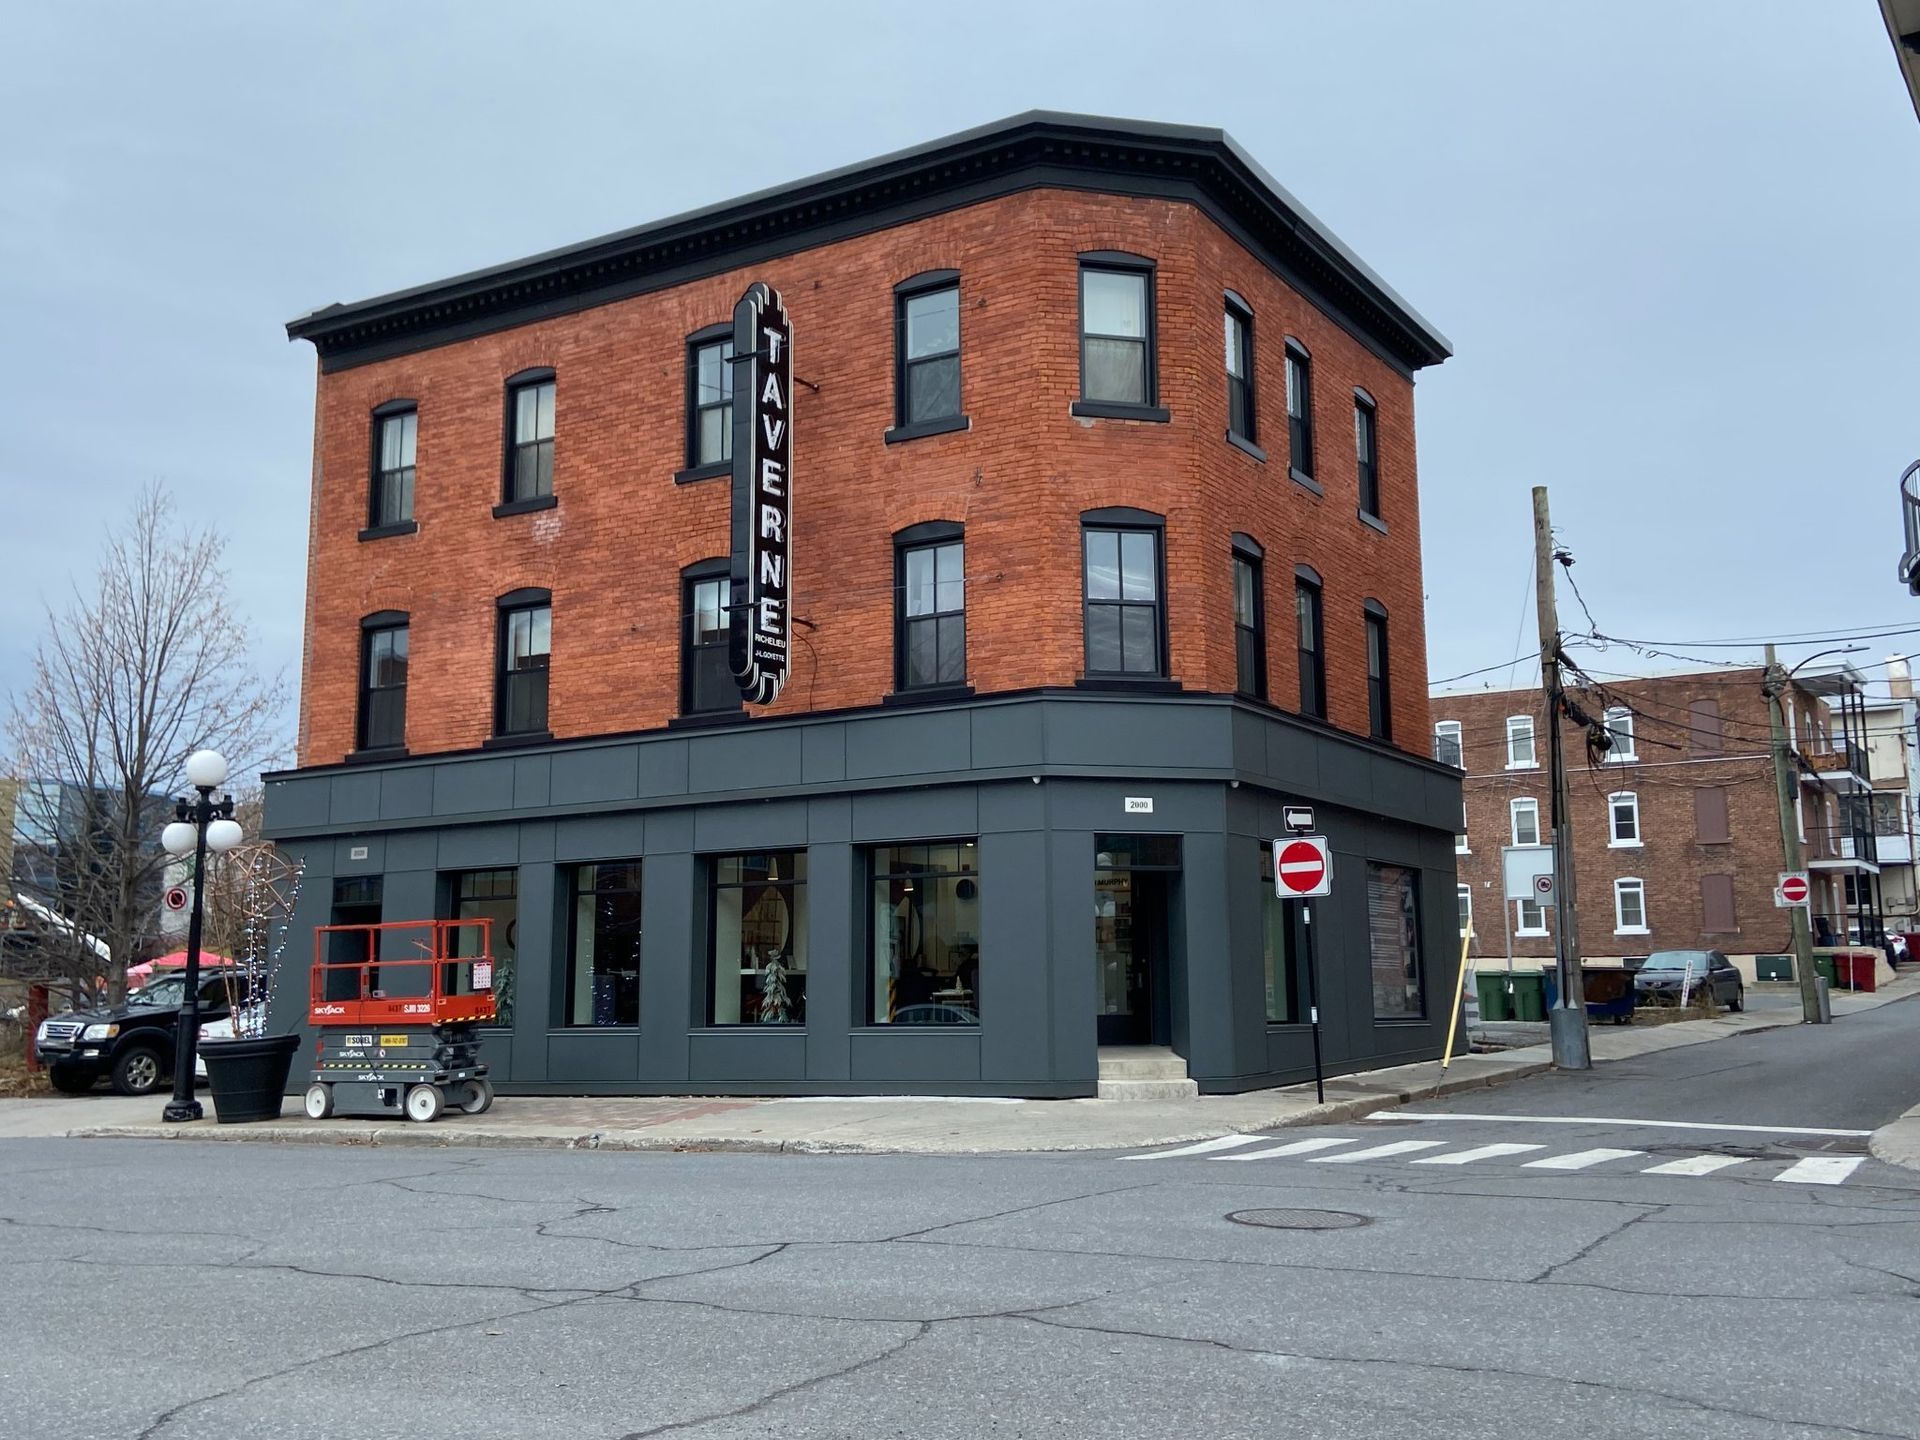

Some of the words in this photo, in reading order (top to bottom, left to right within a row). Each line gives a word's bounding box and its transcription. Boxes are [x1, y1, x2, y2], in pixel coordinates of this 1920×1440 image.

[760, 326, 787, 634] TAVERNE
[754, 633, 786, 649] RICHELIEU
[1130, 800, 1149, 809] 2000
[314, 1004, 345, 1015] SKYJACK
[339, 1049, 365, 1058] SKYJACK
